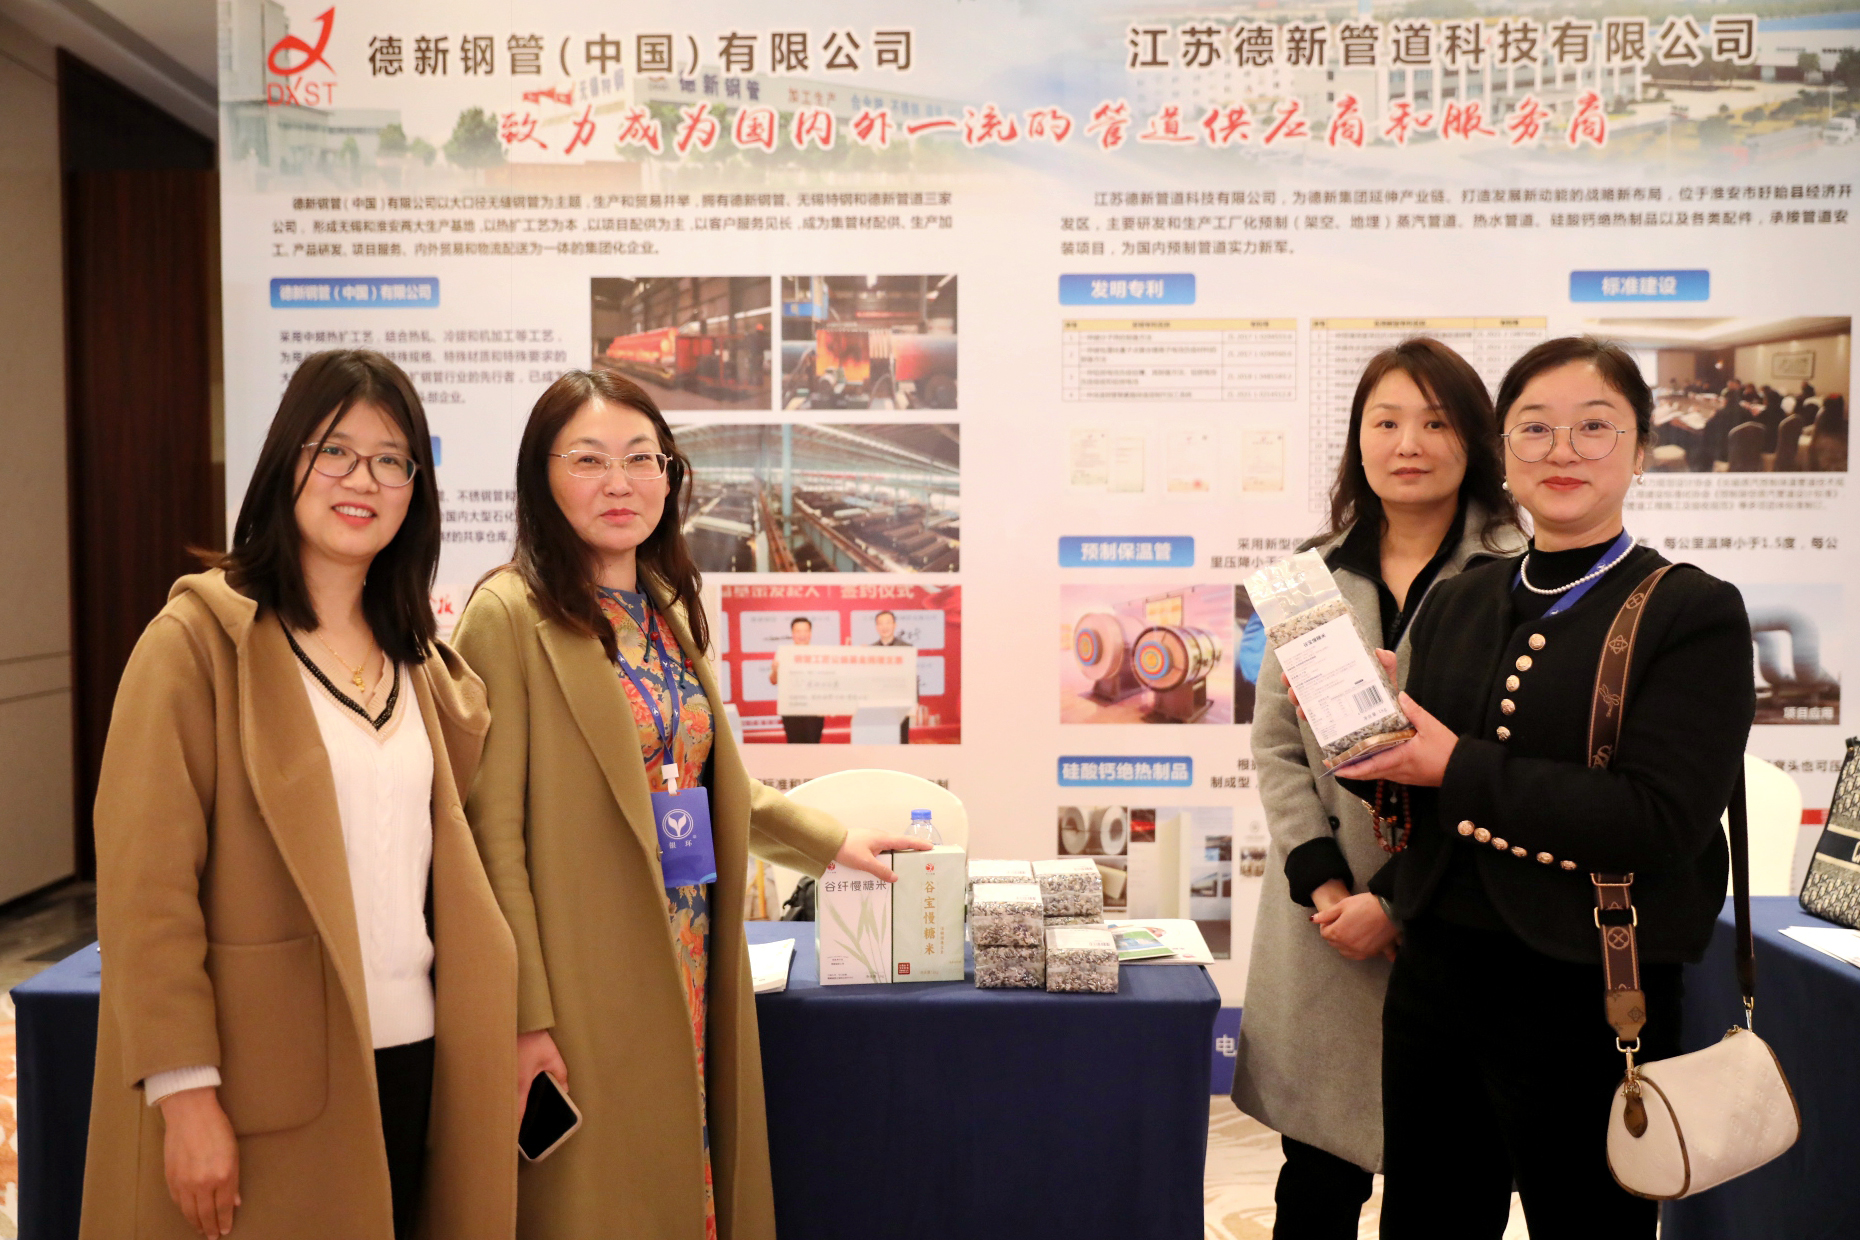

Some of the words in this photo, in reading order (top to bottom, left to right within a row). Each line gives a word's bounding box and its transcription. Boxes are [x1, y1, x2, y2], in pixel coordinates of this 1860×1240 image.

[368, 30, 914, 77] 德新钢管(中国)有限公司
[1129, 18, 1757, 69] 江苏德新管道科技有限公司
[267, 77, 338, 107] DXST
[500, 91, 1610, 155] 致力成为国内外一流的管道供应商和服务商
[1091, 279, 1165, 299] 发明专利
[1601, 276, 1677, 296] 标准建设
[441, 510, 515, 522] 国内大型石化
[1081, 542, 1172, 562] 预制保温管
[1211, 555, 1284, 568] 里压降小于
[1783, 706, 1834, 720] 项目应用
[1062, 762, 1189, 781] 硅酸钙绝热制品
[825, 880, 887, 893] 谷纤慢糖米
[923, 881, 936, 956] 谷宝慢糖米
[1215, 1033, 1238, 1057] 电
